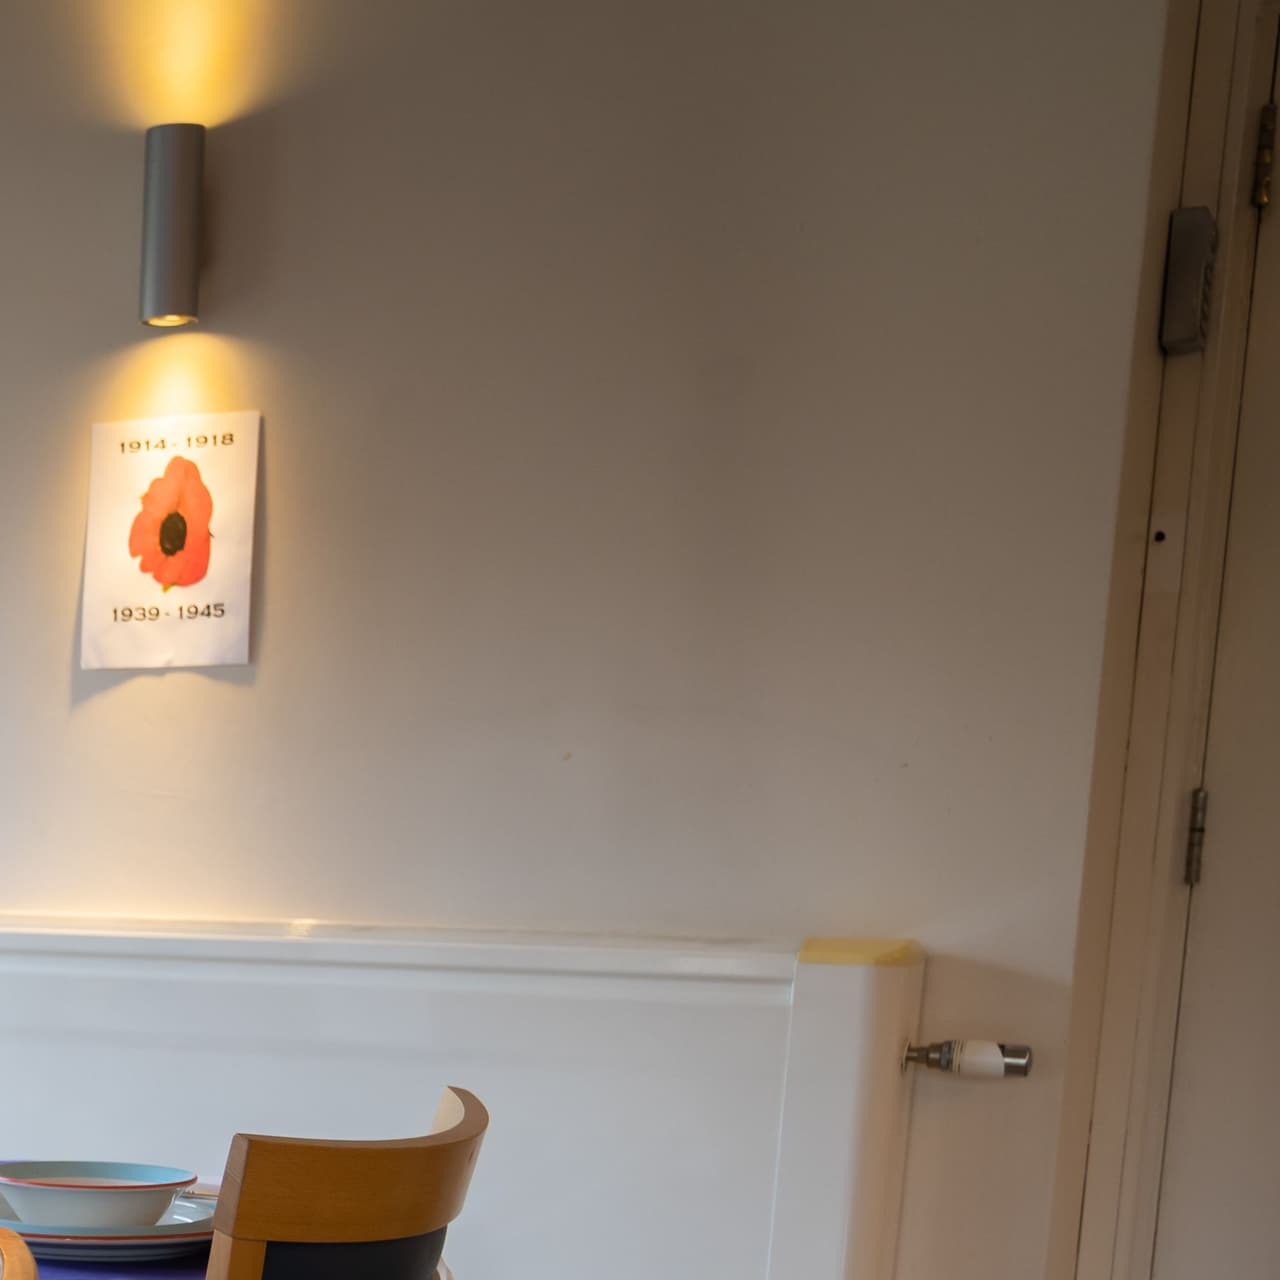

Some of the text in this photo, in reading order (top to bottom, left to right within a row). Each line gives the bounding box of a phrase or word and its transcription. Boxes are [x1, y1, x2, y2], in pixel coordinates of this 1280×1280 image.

[120, 439, 166, 454] 1914
[186, 433, 235, 448] 1918
[113, 607, 160, 622] 1939
[178, 603, 225, 620] 1945
